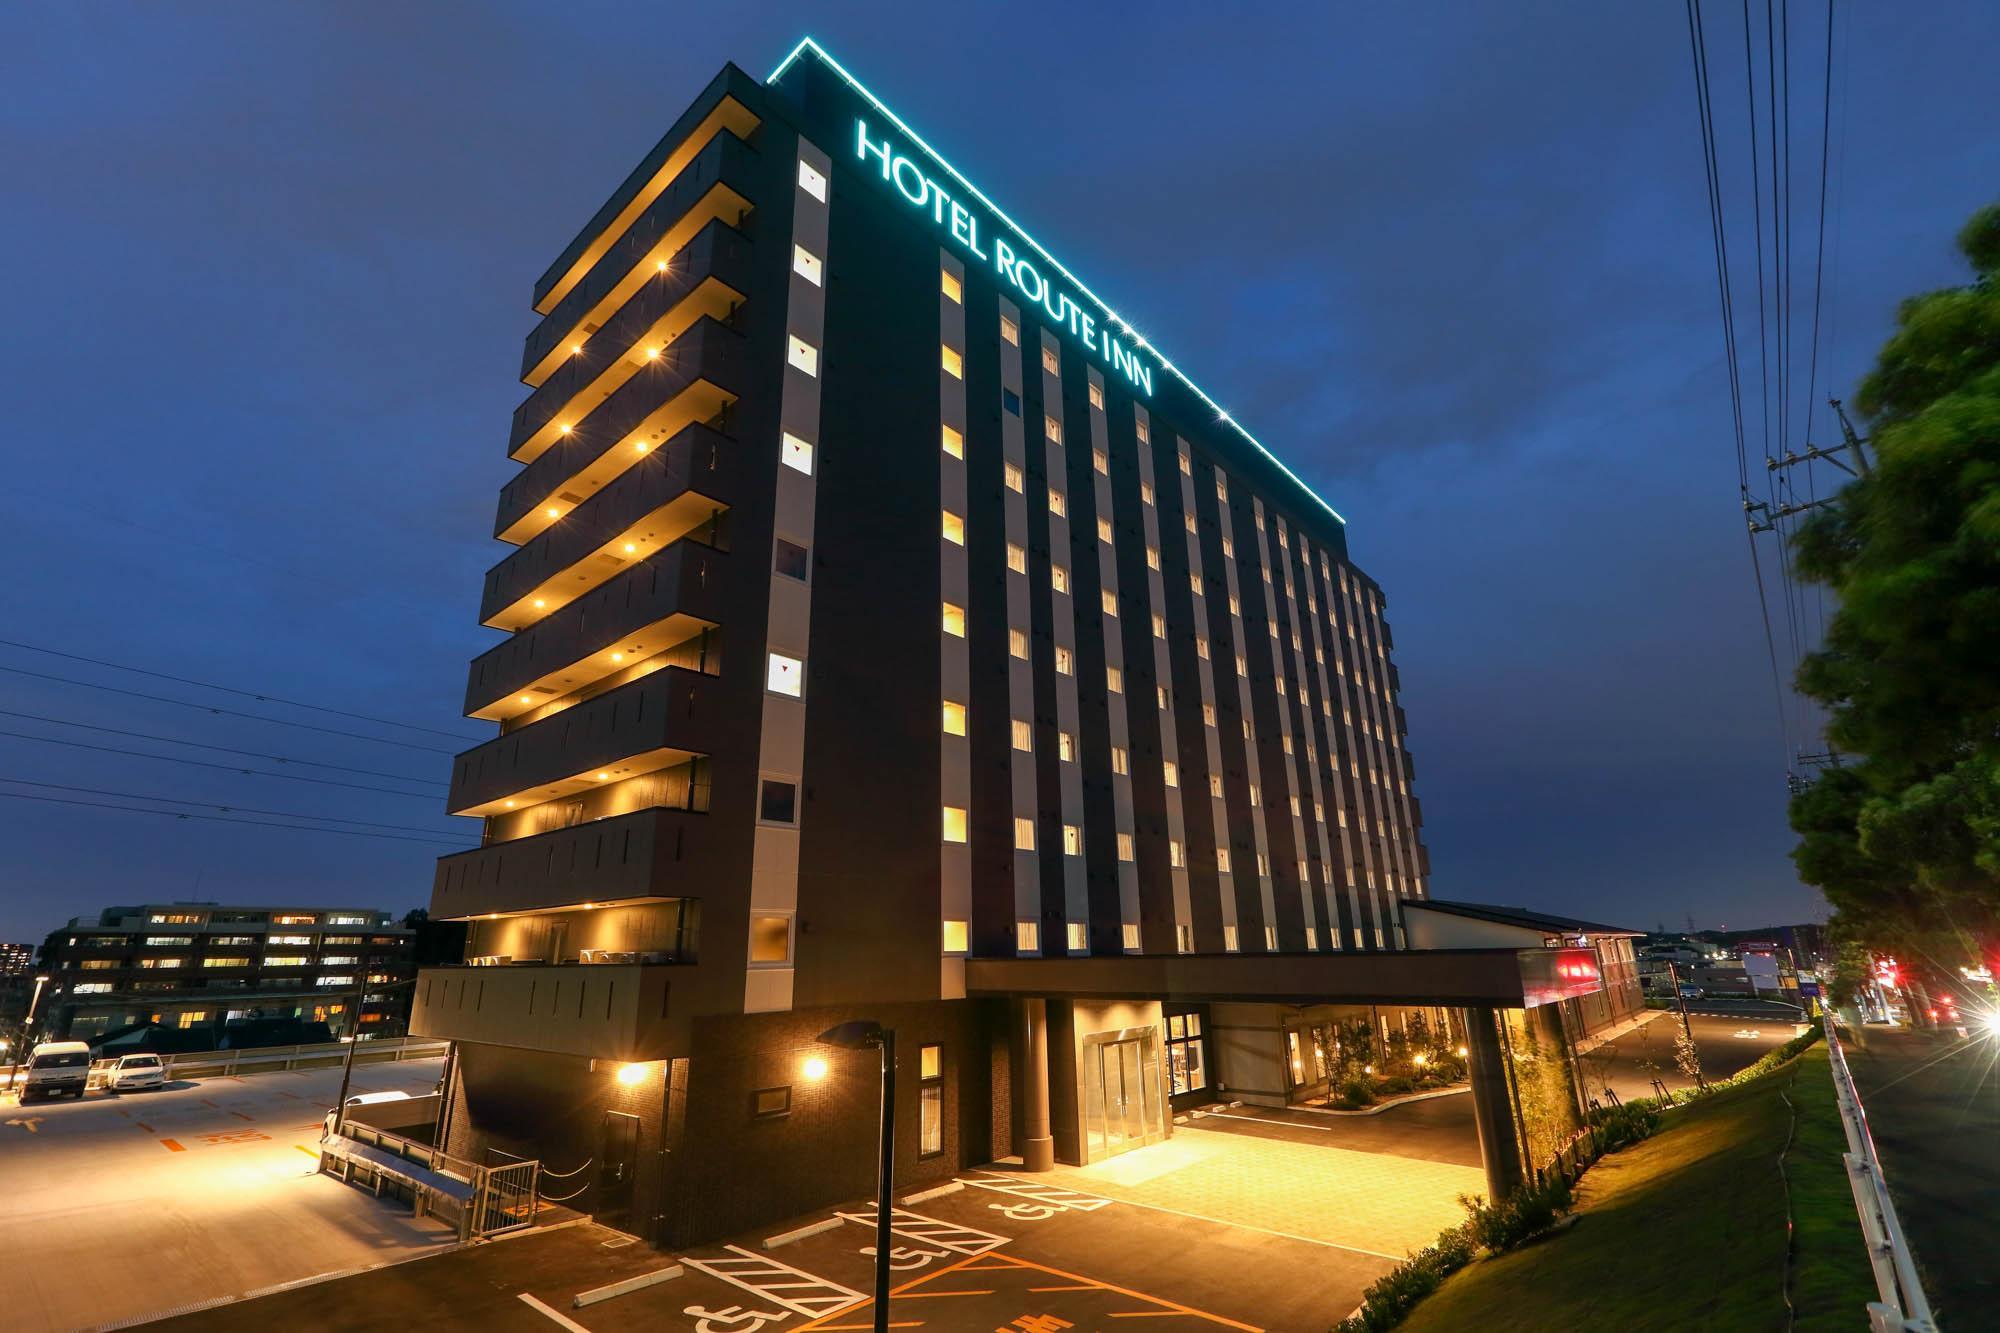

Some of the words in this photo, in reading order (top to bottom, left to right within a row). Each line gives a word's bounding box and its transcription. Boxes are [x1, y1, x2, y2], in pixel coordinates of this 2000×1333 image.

[856, 119, 987, 261] HOTEL
[996, 238, 1097, 351] ROUTE
[1102, 330, 1152, 397] INN
